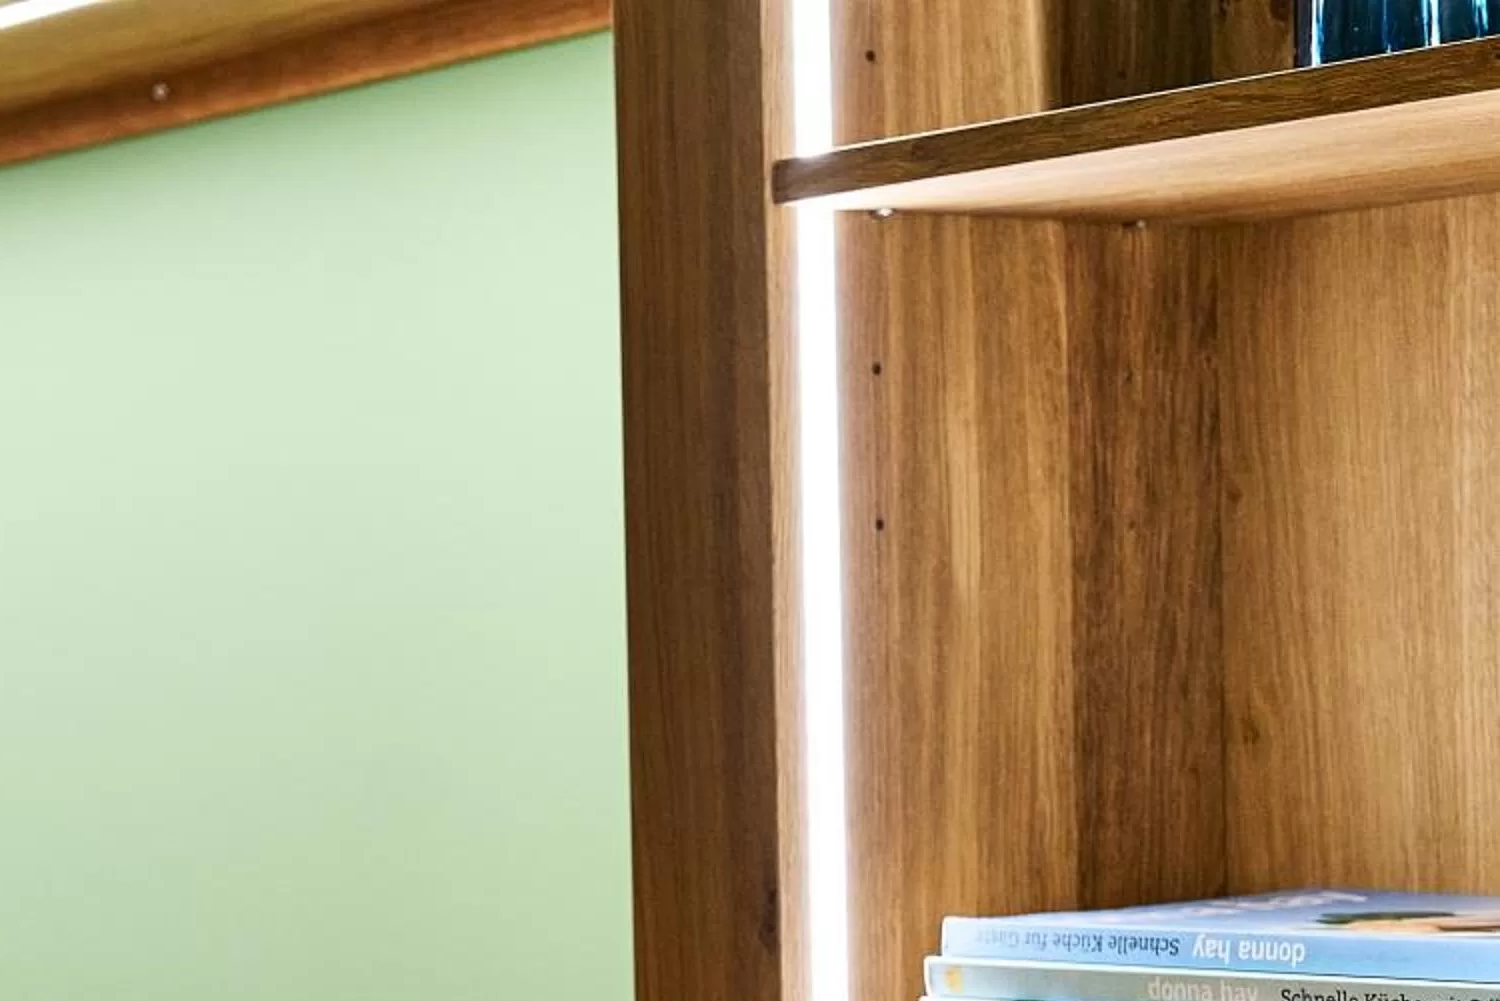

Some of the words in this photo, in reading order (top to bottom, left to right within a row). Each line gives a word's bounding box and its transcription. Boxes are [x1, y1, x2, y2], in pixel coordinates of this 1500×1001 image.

[1052, 932, 1103, 953] Küche
[1107, 934, 1181, 957] Schnelle
[1192, 933, 1230, 965] hay
[1237, 938, 1306, 969] donna
[1148, 976, 1213, 1001] donna
